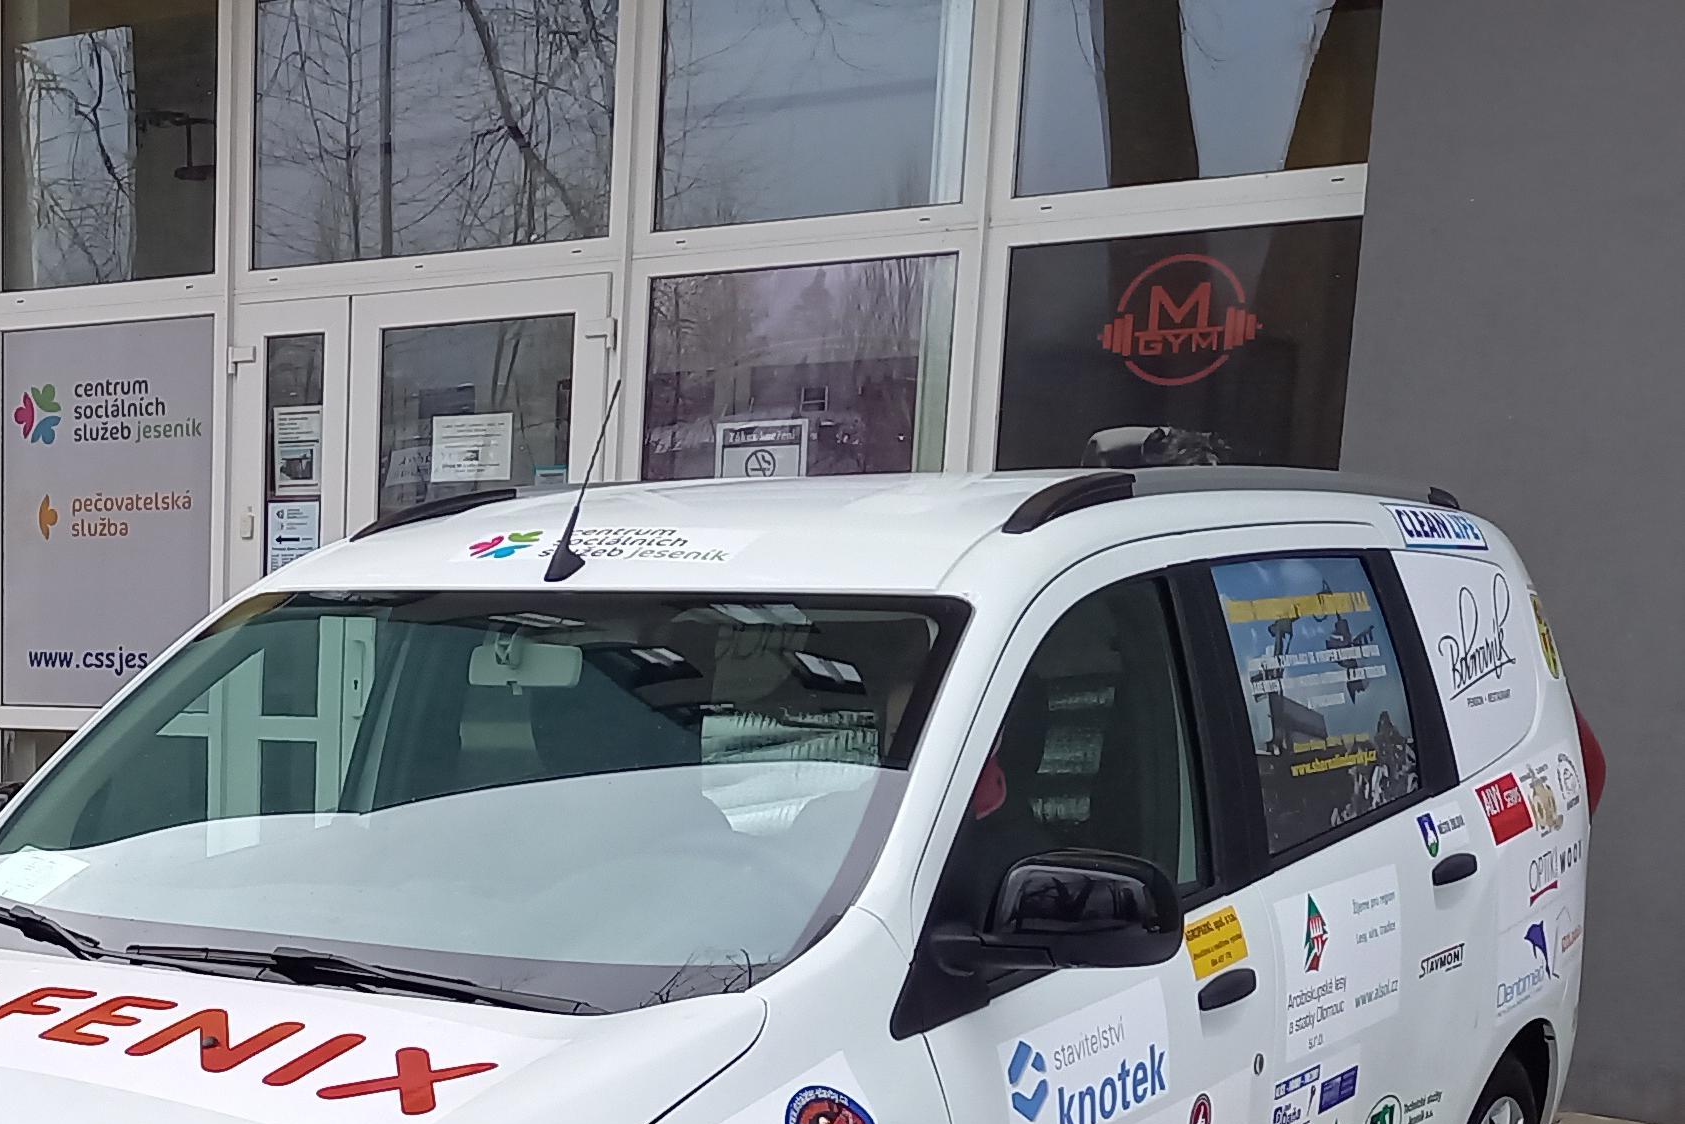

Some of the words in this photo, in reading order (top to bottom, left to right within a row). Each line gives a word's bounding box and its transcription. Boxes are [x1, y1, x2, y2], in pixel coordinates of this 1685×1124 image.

[1148, 282, 1211, 331] M
[1138, 332, 1218, 355] GYM
[74, 379, 148, 397] centrum
[74, 398, 165, 419] sociálních
[74, 422, 131, 442] služeb
[135, 419, 202, 443] jeseník
[72, 491, 192, 516] pečovatelská
[71, 518, 128, 537] služba
[1395, 509, 1452, 539] CLEAN
[1440, 512, 1481, 540] LIFE
[623, 547, 731, 562] jeseník
[28, 647, 148, 676] www.cssjes
[1419, 943, 1465, 979] STAVMONT
[1054, 1015, 1125, 1070] stavitelství
